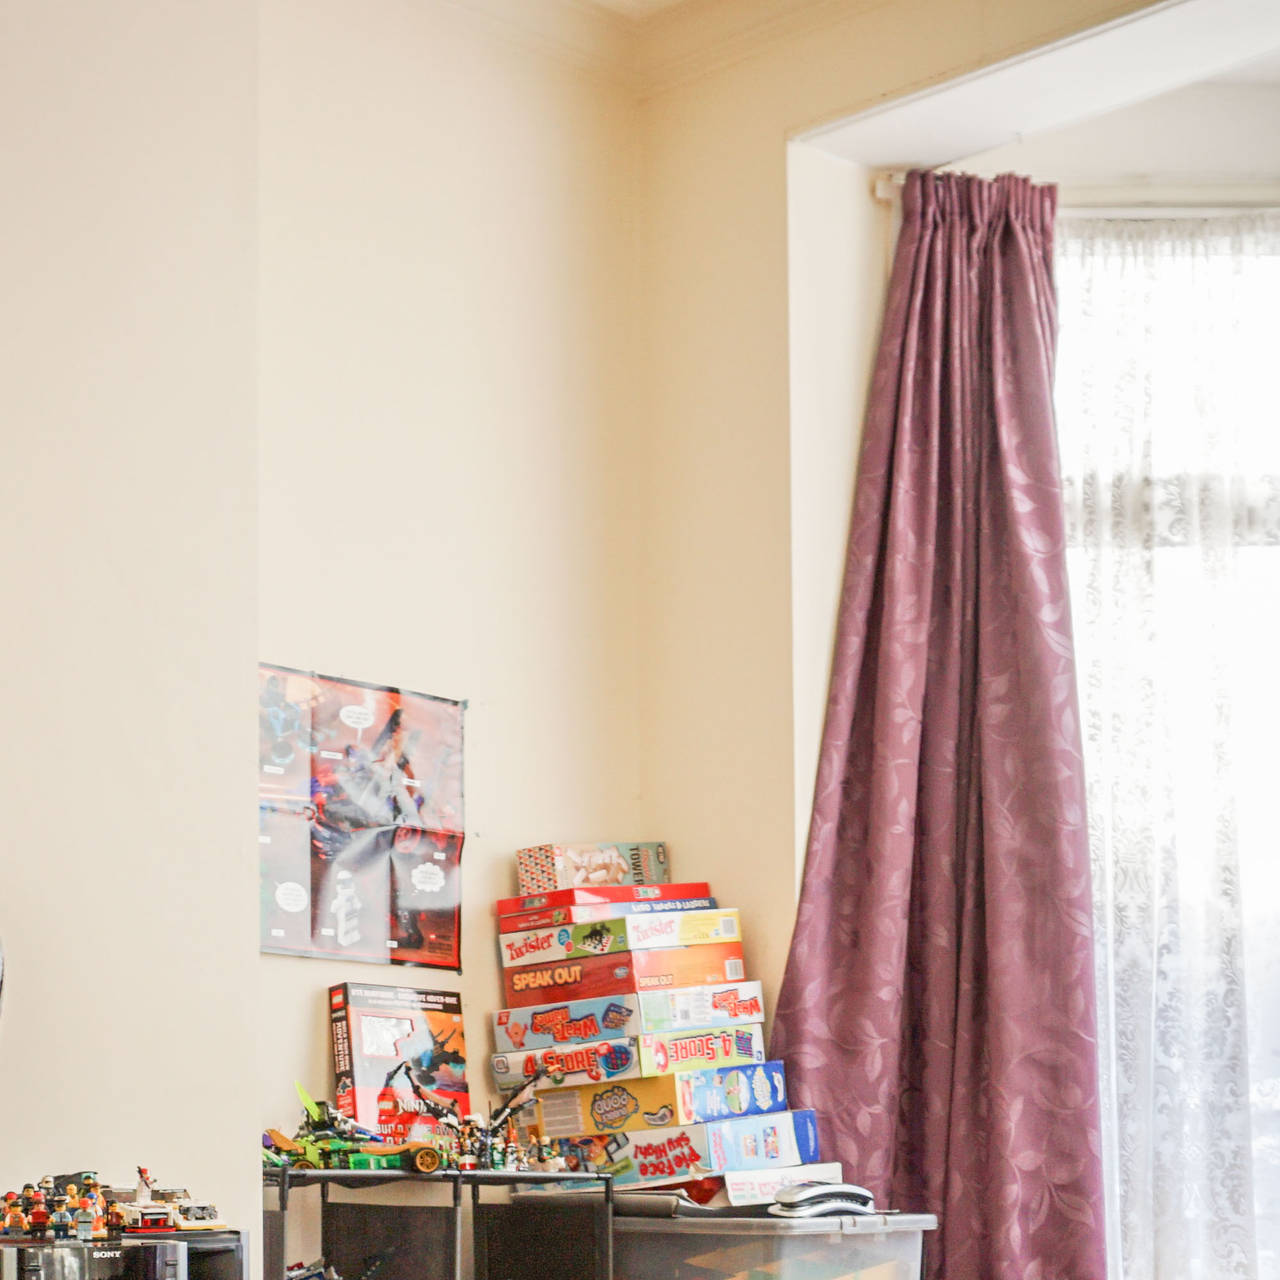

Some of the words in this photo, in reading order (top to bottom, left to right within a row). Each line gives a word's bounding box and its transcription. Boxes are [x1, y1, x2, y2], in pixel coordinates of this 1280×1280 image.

[513, 970, 552, 992] SPEAK
[554, 965, 582, 984] OUT
[639, 1158, 676, 1177] Face
[92, 1250, 122, 1259] SONY
